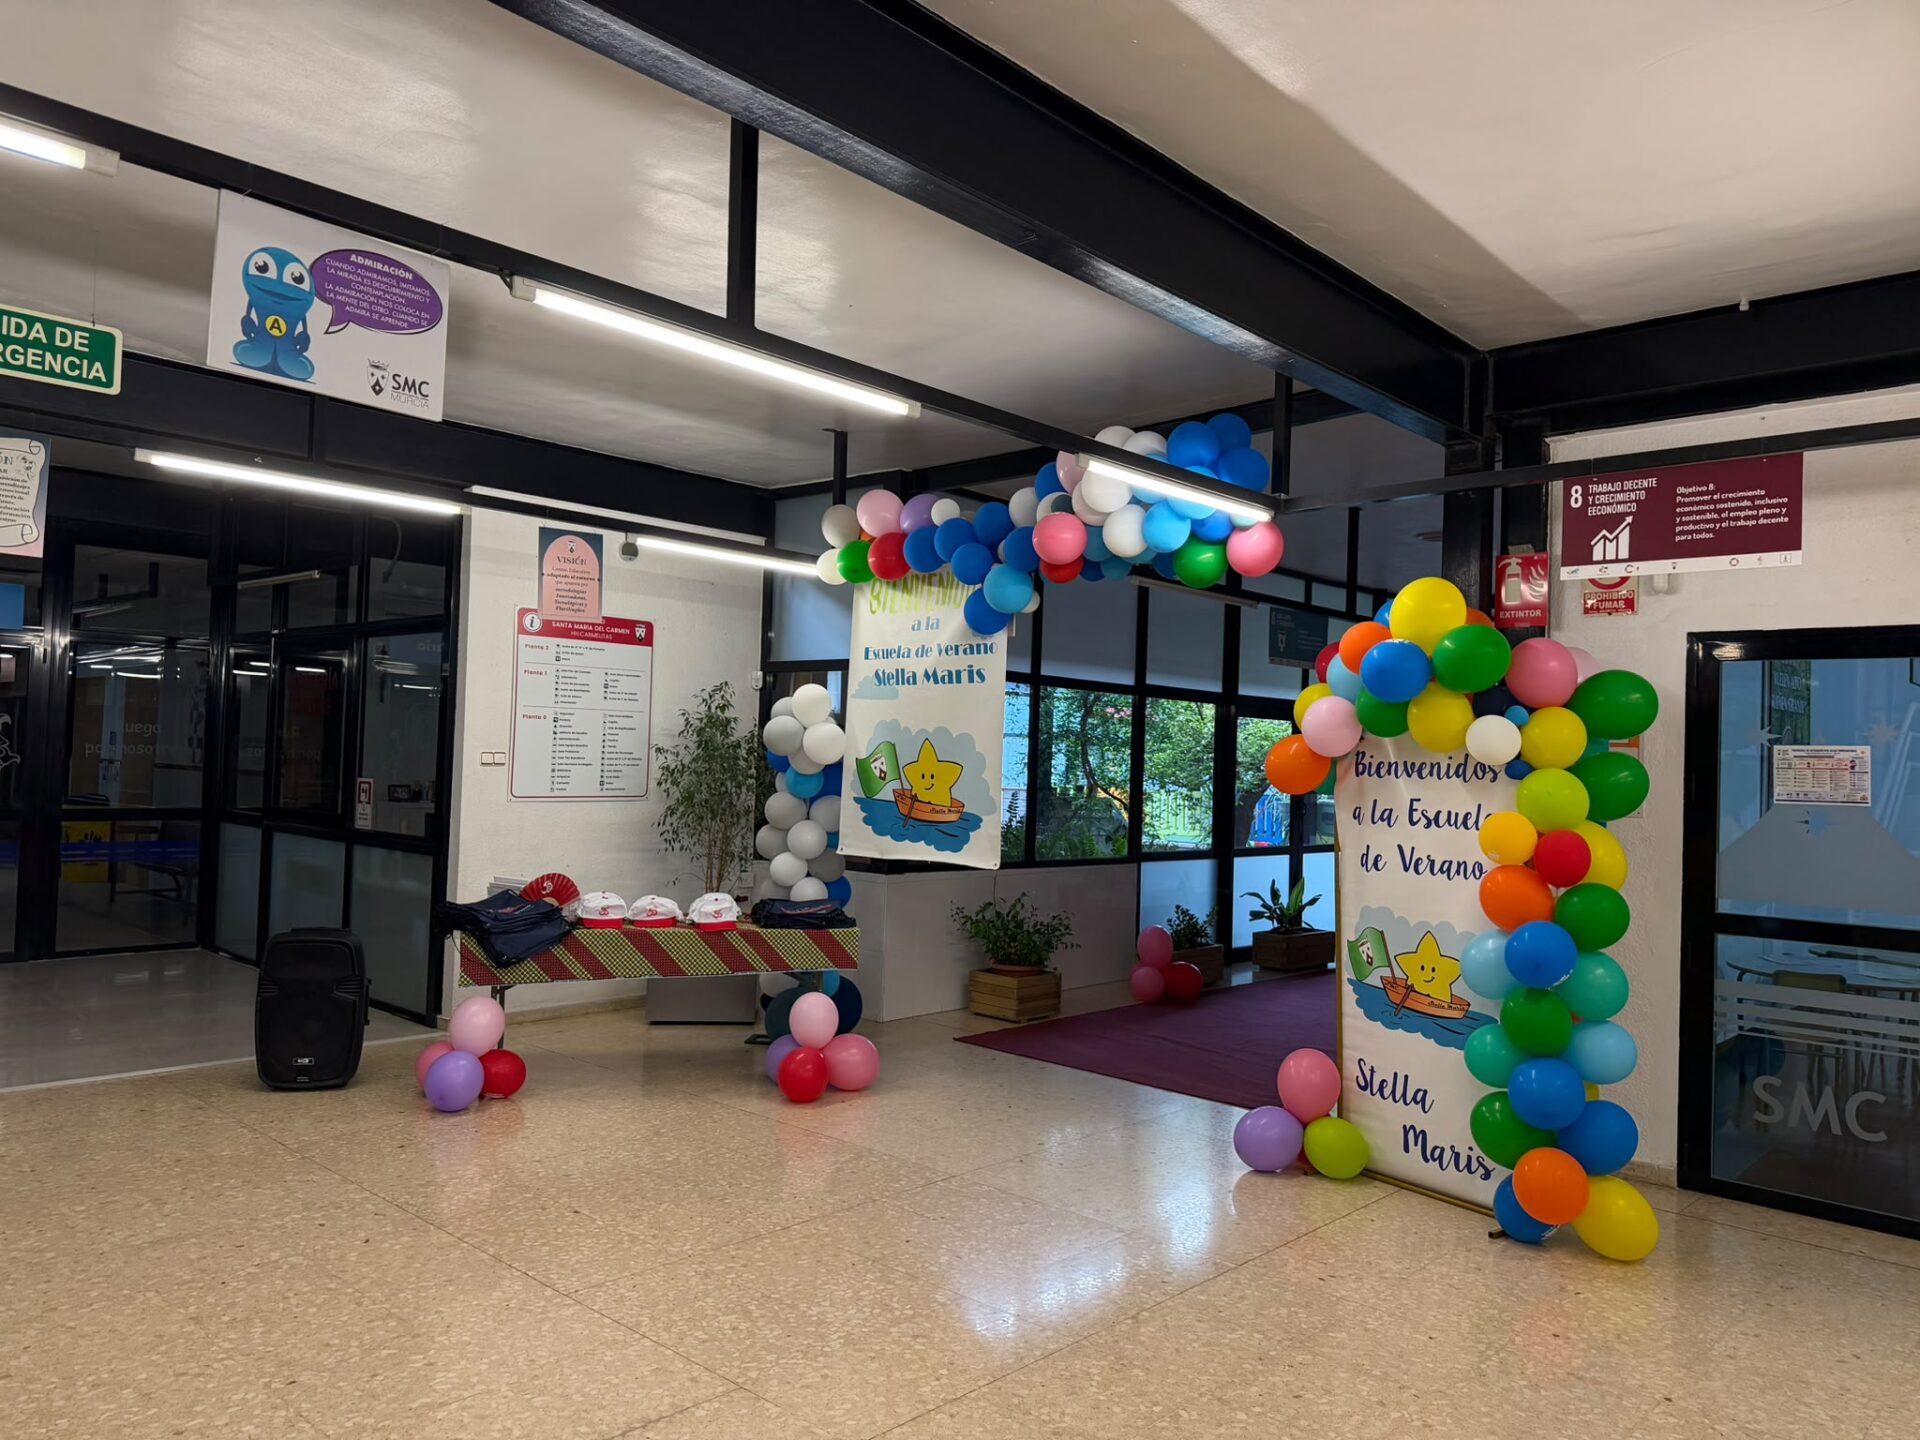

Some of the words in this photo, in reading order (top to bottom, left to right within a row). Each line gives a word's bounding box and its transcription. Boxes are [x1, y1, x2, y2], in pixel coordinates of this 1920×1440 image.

[326, 258, 356, 272] CUANDO
[350, 254, 413, 280] ADMIRACIÓN
[337, 270, 362, 283] MIRADA
[364, 277, 371, 285] ES
[372, 280, 425, 302] DESCUBRIMIENTO
[336, 294, 358, 306] MENTE
[359, 301, 370, 309] DEL
[392, 310, 419, 324] CUANDO
[421, 319, 428, 327] SE
[345, 305, 371, 317] ADMIRA
[372, 312, 379, 320] SE
[379, 300, 392, 308] NOS
[394, 303, 420, 317] COLOCA
[269, 317, 283, 334] A
[55, 326, 89, 352] DE
[392, 373, 430, 398] SMC
[1588, 481, 1621, 494] TRABAJO
[1623, 477, 1657, 490] DECENTE
[1676, 485, 1707, 495] Objetivo
[1570, 485, 1582, 508] 8
[1588, 496, 1593, 505] Y
[1595, 490, 1645, 504] CRECIMIENTO
[1676, 494, 1712, 503] Promover
[1721, 489, 1766, 499] crecimiento
[1676, 503, 1715, 513] económico
[1754, 496, 1788, 506] inclusivo
[1588, 502, 1637, 516] EECONÓMICO
[1721, 510, 1728, 518] el
[1729, 508, 1758, 518] empleo
[1758, 507, 1780, 516] pleno
[1781, 506, 1787, 514] y
[1675, 523, 1715, 533] productivo
[1729, 518, 1757, 527] trabajo
[1758, 516, 1789, 525] decente
[1675, 534, 1692, 542] para
[1692, 531, 1715, 540] todos.
[557, 555, 587, 565] VISIÓN
[1584, 590, 1634, 601] PROHIBIDO
[1592, 600, 1625, 609] FUMAR
[1499, 609, 1542, 619] EXTINTOR
[552, 621, 573, 629] SANTA
[606, 626, 630, 635] CARMEN
[911, 619, 921, 632] a
[925, 616, 940, 631] la
[864, 645, 912, 661] Escuela
[915, 644, 933, 658] de
[936, 641, 998, 657] Verano
[874, 668, 918, 687] Stella
[922, 664, 986, 685] Maris
[1355, 750, 1501, 783] Bienvenidos
[1352, 805, 1365, 825] a
[1370, 798, 1399, 828] la
[1408, 798, 1492, 831] Escuel
[1360, 844, 1387, 872] de
[1397, 843, 1488, 881] Verano
[1356, 1058, 1435, 1114] Stella
[1752, 1075, 1889, 1142] SMC
[1402, 1124, 1496, 1181] Maris
